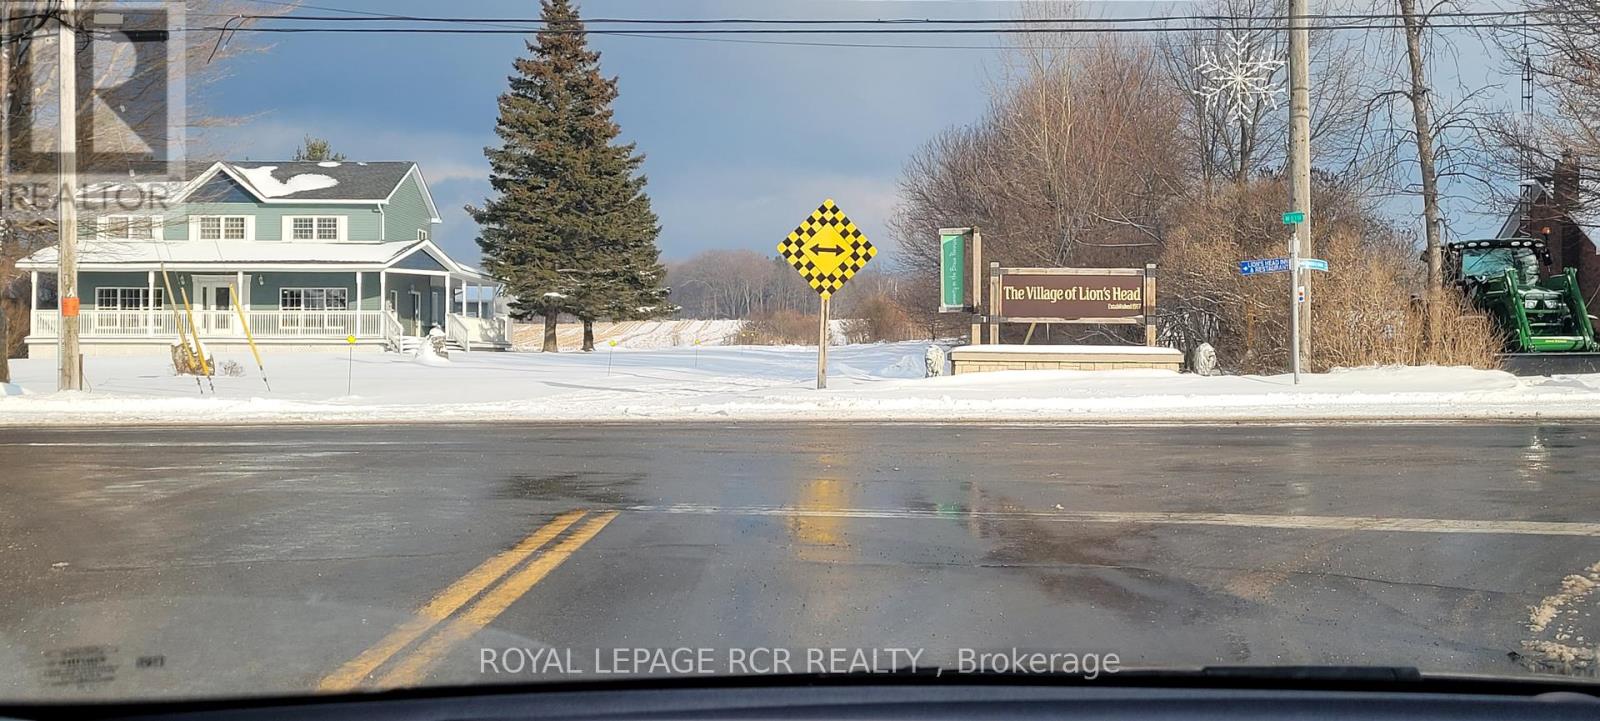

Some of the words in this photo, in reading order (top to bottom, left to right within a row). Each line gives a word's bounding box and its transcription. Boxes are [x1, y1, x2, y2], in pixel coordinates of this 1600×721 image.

[1265, 259, 1279, 267] HEAD
[1255, 265, 1289, 273] RESTAURANT
[1003, 286, 1024, 300] The
[1026, 286, 1064, 303] Village
[1064, 286, 1078, 300] of
[1078, 286, 1110, 301] Lion's
[1112, 287, 1142, 301] Head
